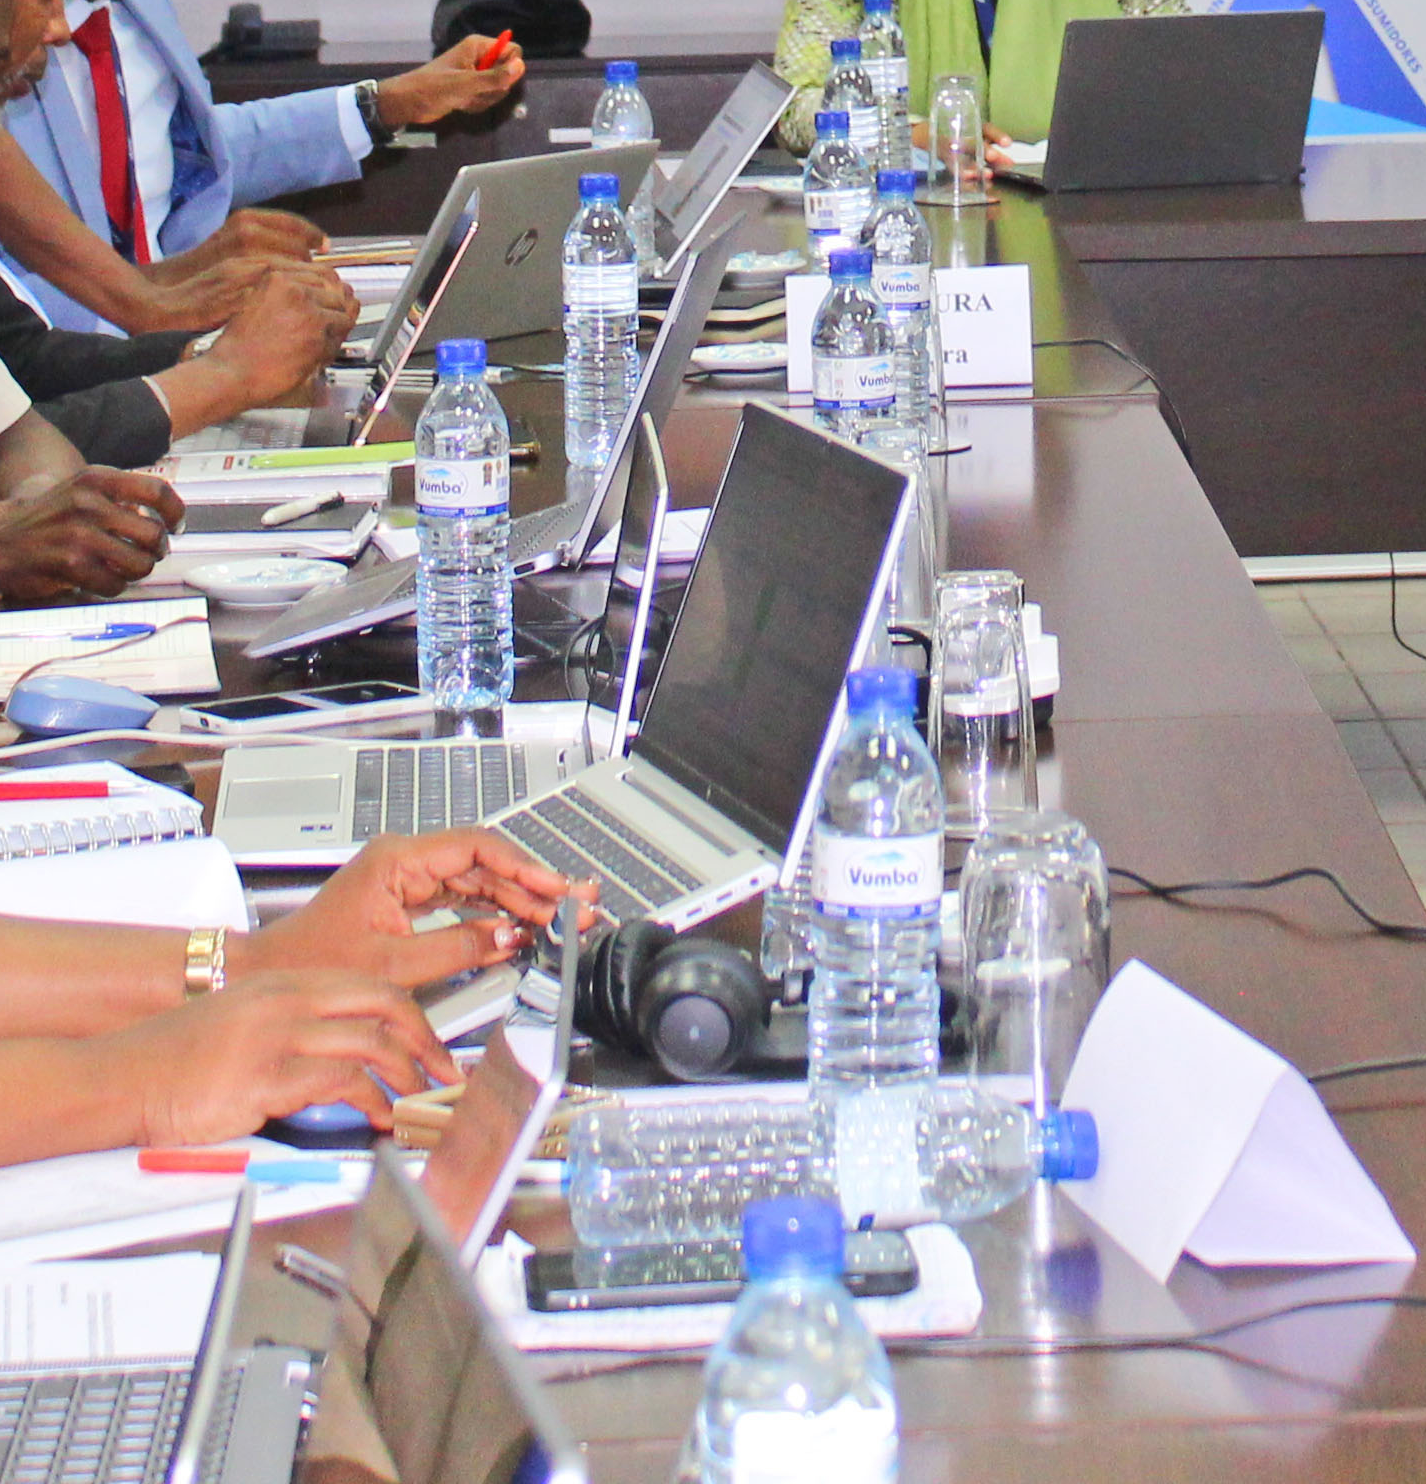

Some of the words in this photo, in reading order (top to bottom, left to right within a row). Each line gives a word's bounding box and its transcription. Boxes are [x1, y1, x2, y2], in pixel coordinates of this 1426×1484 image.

[881, 278, 921, 294] Vumba
[936, 293, 994, 313] URA
[419, 477, 462, 494] Vumba
[849, 866, 918, 887] Vumba
